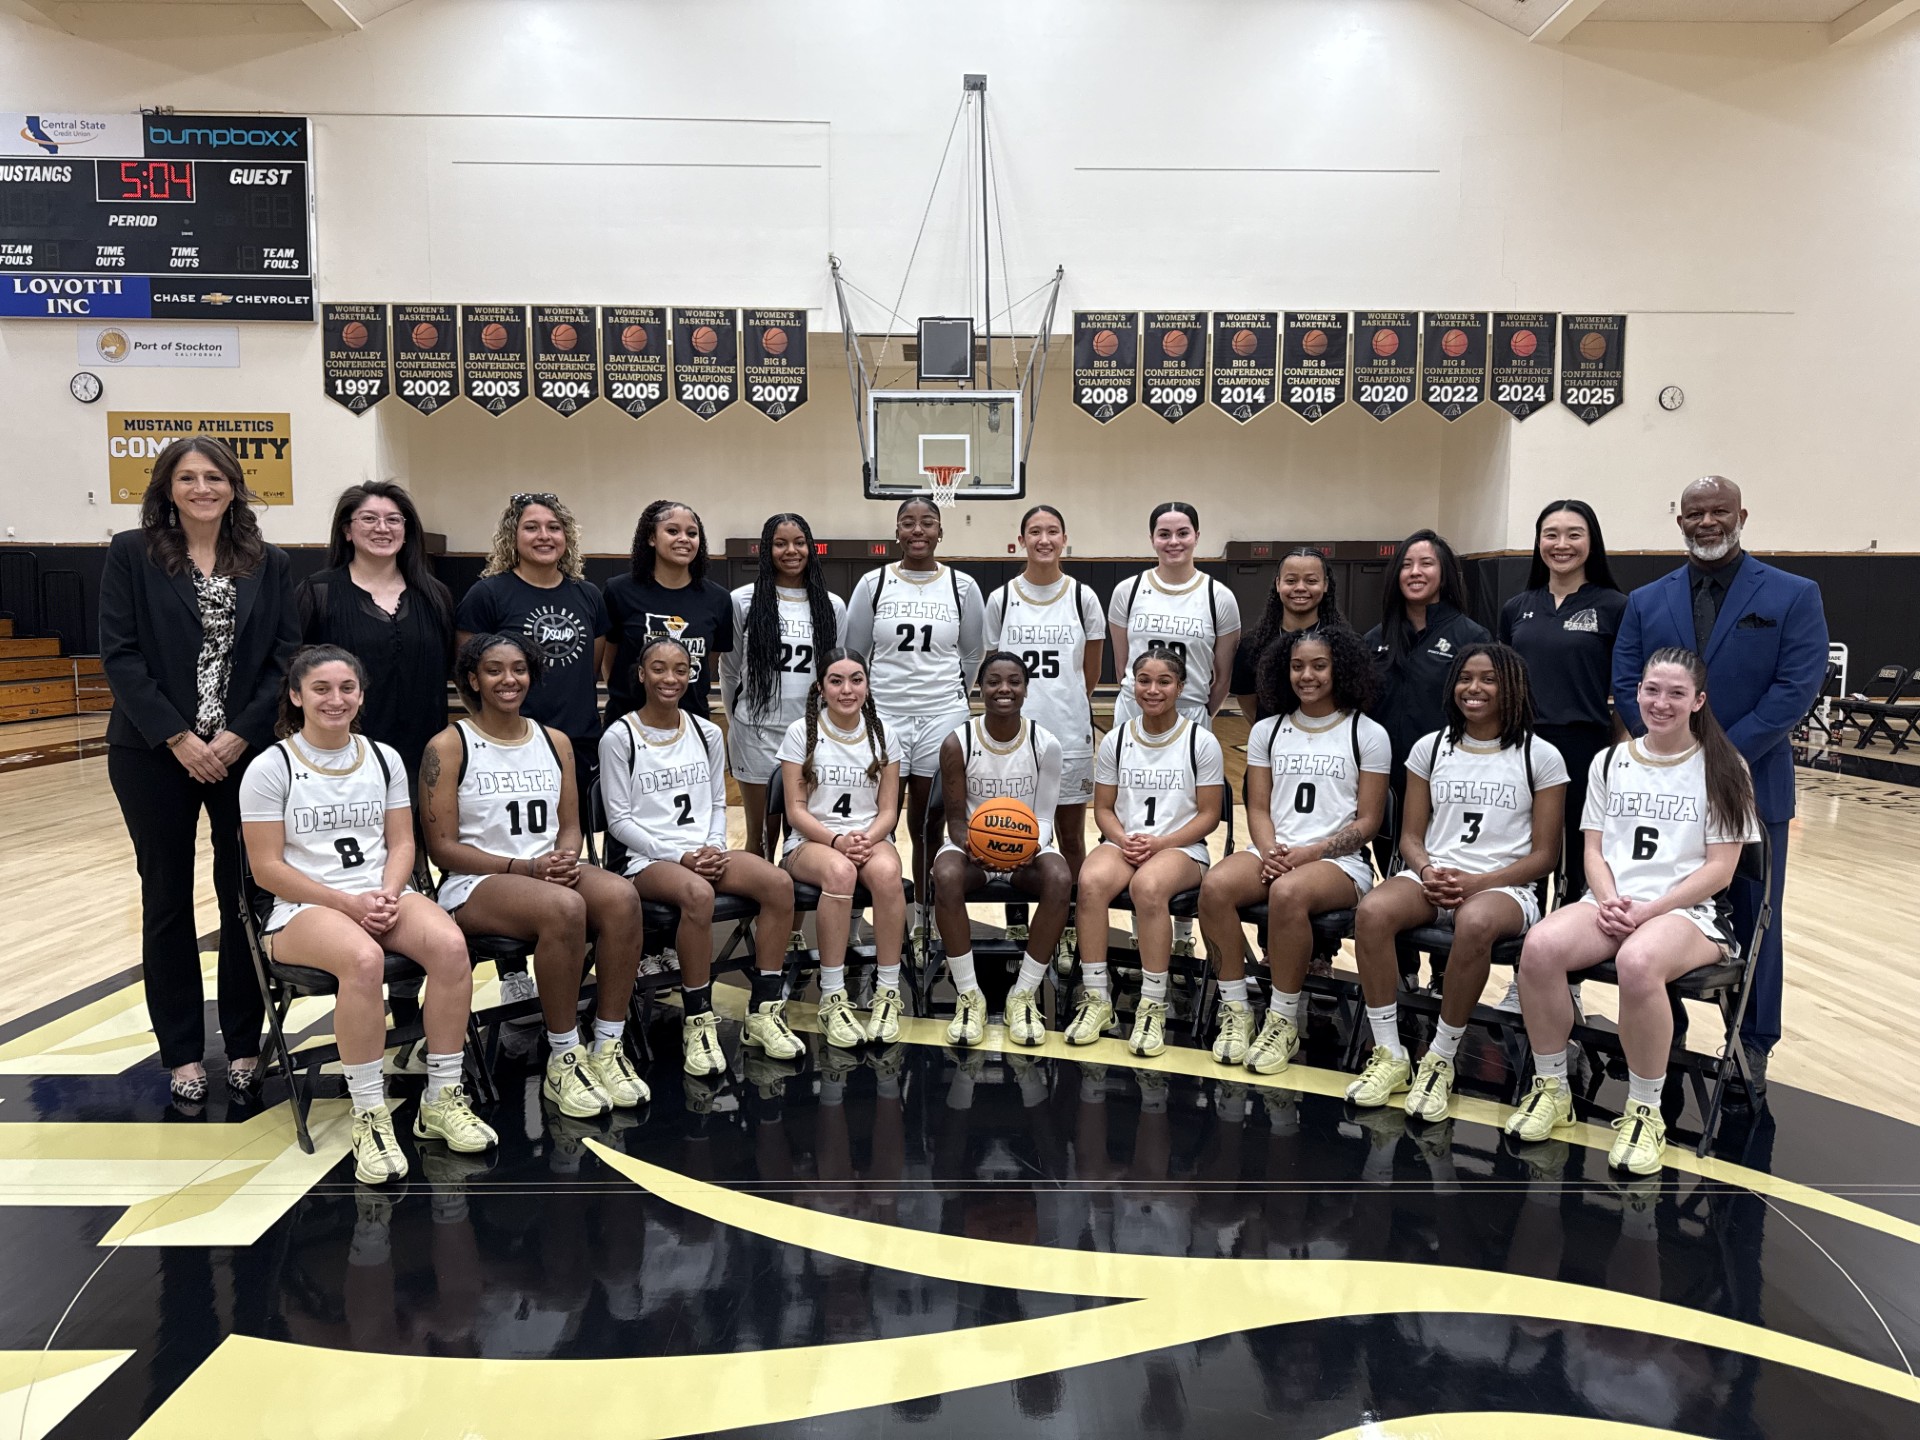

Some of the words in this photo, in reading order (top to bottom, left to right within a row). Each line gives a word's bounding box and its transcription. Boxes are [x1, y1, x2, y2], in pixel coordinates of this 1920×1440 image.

[41, 120, 77, 129] Central
[80, 121, 106, 129] State
[150, 126, 298, 148] bumpboxx
[121, 162, 191, 198] 5:04
[229, 169, 292, 185] GUEST
[108, 215, 158, 226] PERIOD
[1, 245, 33, 254] TEAM
[97, 246, 125, 256] TIME
[171, 247, 199, 256] TIME
[263, 248, 294, 258] TEAM
[96, 257, 125, 267] OUTS
[170, 258, 199, 267] OUTS
[264, 259, 299, 269] FOULS
[13, 279, 122, 294] LOVOTTI
[47, 299, 90, 314] INC
[154, 294, 196, 302] CHASE
[236, 295, 309, 304] CHEVROLET
[134, 342, 158, 350] Port
[161, 342, 172, 350] of
[175, 342, 222, 351] Stockton
[749, 375, 802, 383] CHAMPIONS
[335, 380, 380, 395] 1997
[403, 380, 450, 396] 2002
[472, 381, 520, 397] 2003
[542, 382, 590, 397] 2004
[612, 383, 660, 399] 2005
[682, 385, 729, 400] 2006
[752, 386, 800, 401] 2007
[1081, 387, 1128, 404] 2008
[1150, 387, 1197, 404] 2009
[1221, 387, 1266, 403] 2014
[1290, 387, 1336, 403] 2015
[1360, 385, 1408, 402] 2020
[1429, 386, 1478, 402] 2022
[1498, 385, 1546, 401] 2024
[1567, 388, 1615, 404] 2025
[124, 420, 192, 431] MUSTANG
[198, 421, 274, 432] ATHLETICS
[1380, 545, 1395, 556] EXIT
[882, 601, 951, 622] DELTA
[1133, 614, 1204, 638] DELTA
[896, 624, 932, 652] 21
[1008, 625, 1074, 644] DELTA
[1022, 650, 1059, 678] 25
[1274, 754, 1345, 780] DELTA
[477, 770, 558, 795] DELTA
[639, 762, 710, 794] DELTA
[1119, 768, 1184, 789] DELTA
[968, 776, 1034, 798] DELTA
[1295, 783, 1315, 814] 0
[1436, 781, 1517, 810] DELTA
[674, 794, 695, 826] 2
[832, 793, 852, 818] 4
[1144, 797, 1156, 826] 1
[1606, 792, 1698, 822] DELTA
[294, 801, 384, 834] DELTA
[505, 799, 547, 835] 10
[984, 815, 1032, 834] Wilson
[1460, 812, 1483, 844] 3
[987, 839, 1023, 853] NCAA
[1632, 826, 1659, 860] 6
[334, 837, 365, 869] 8
